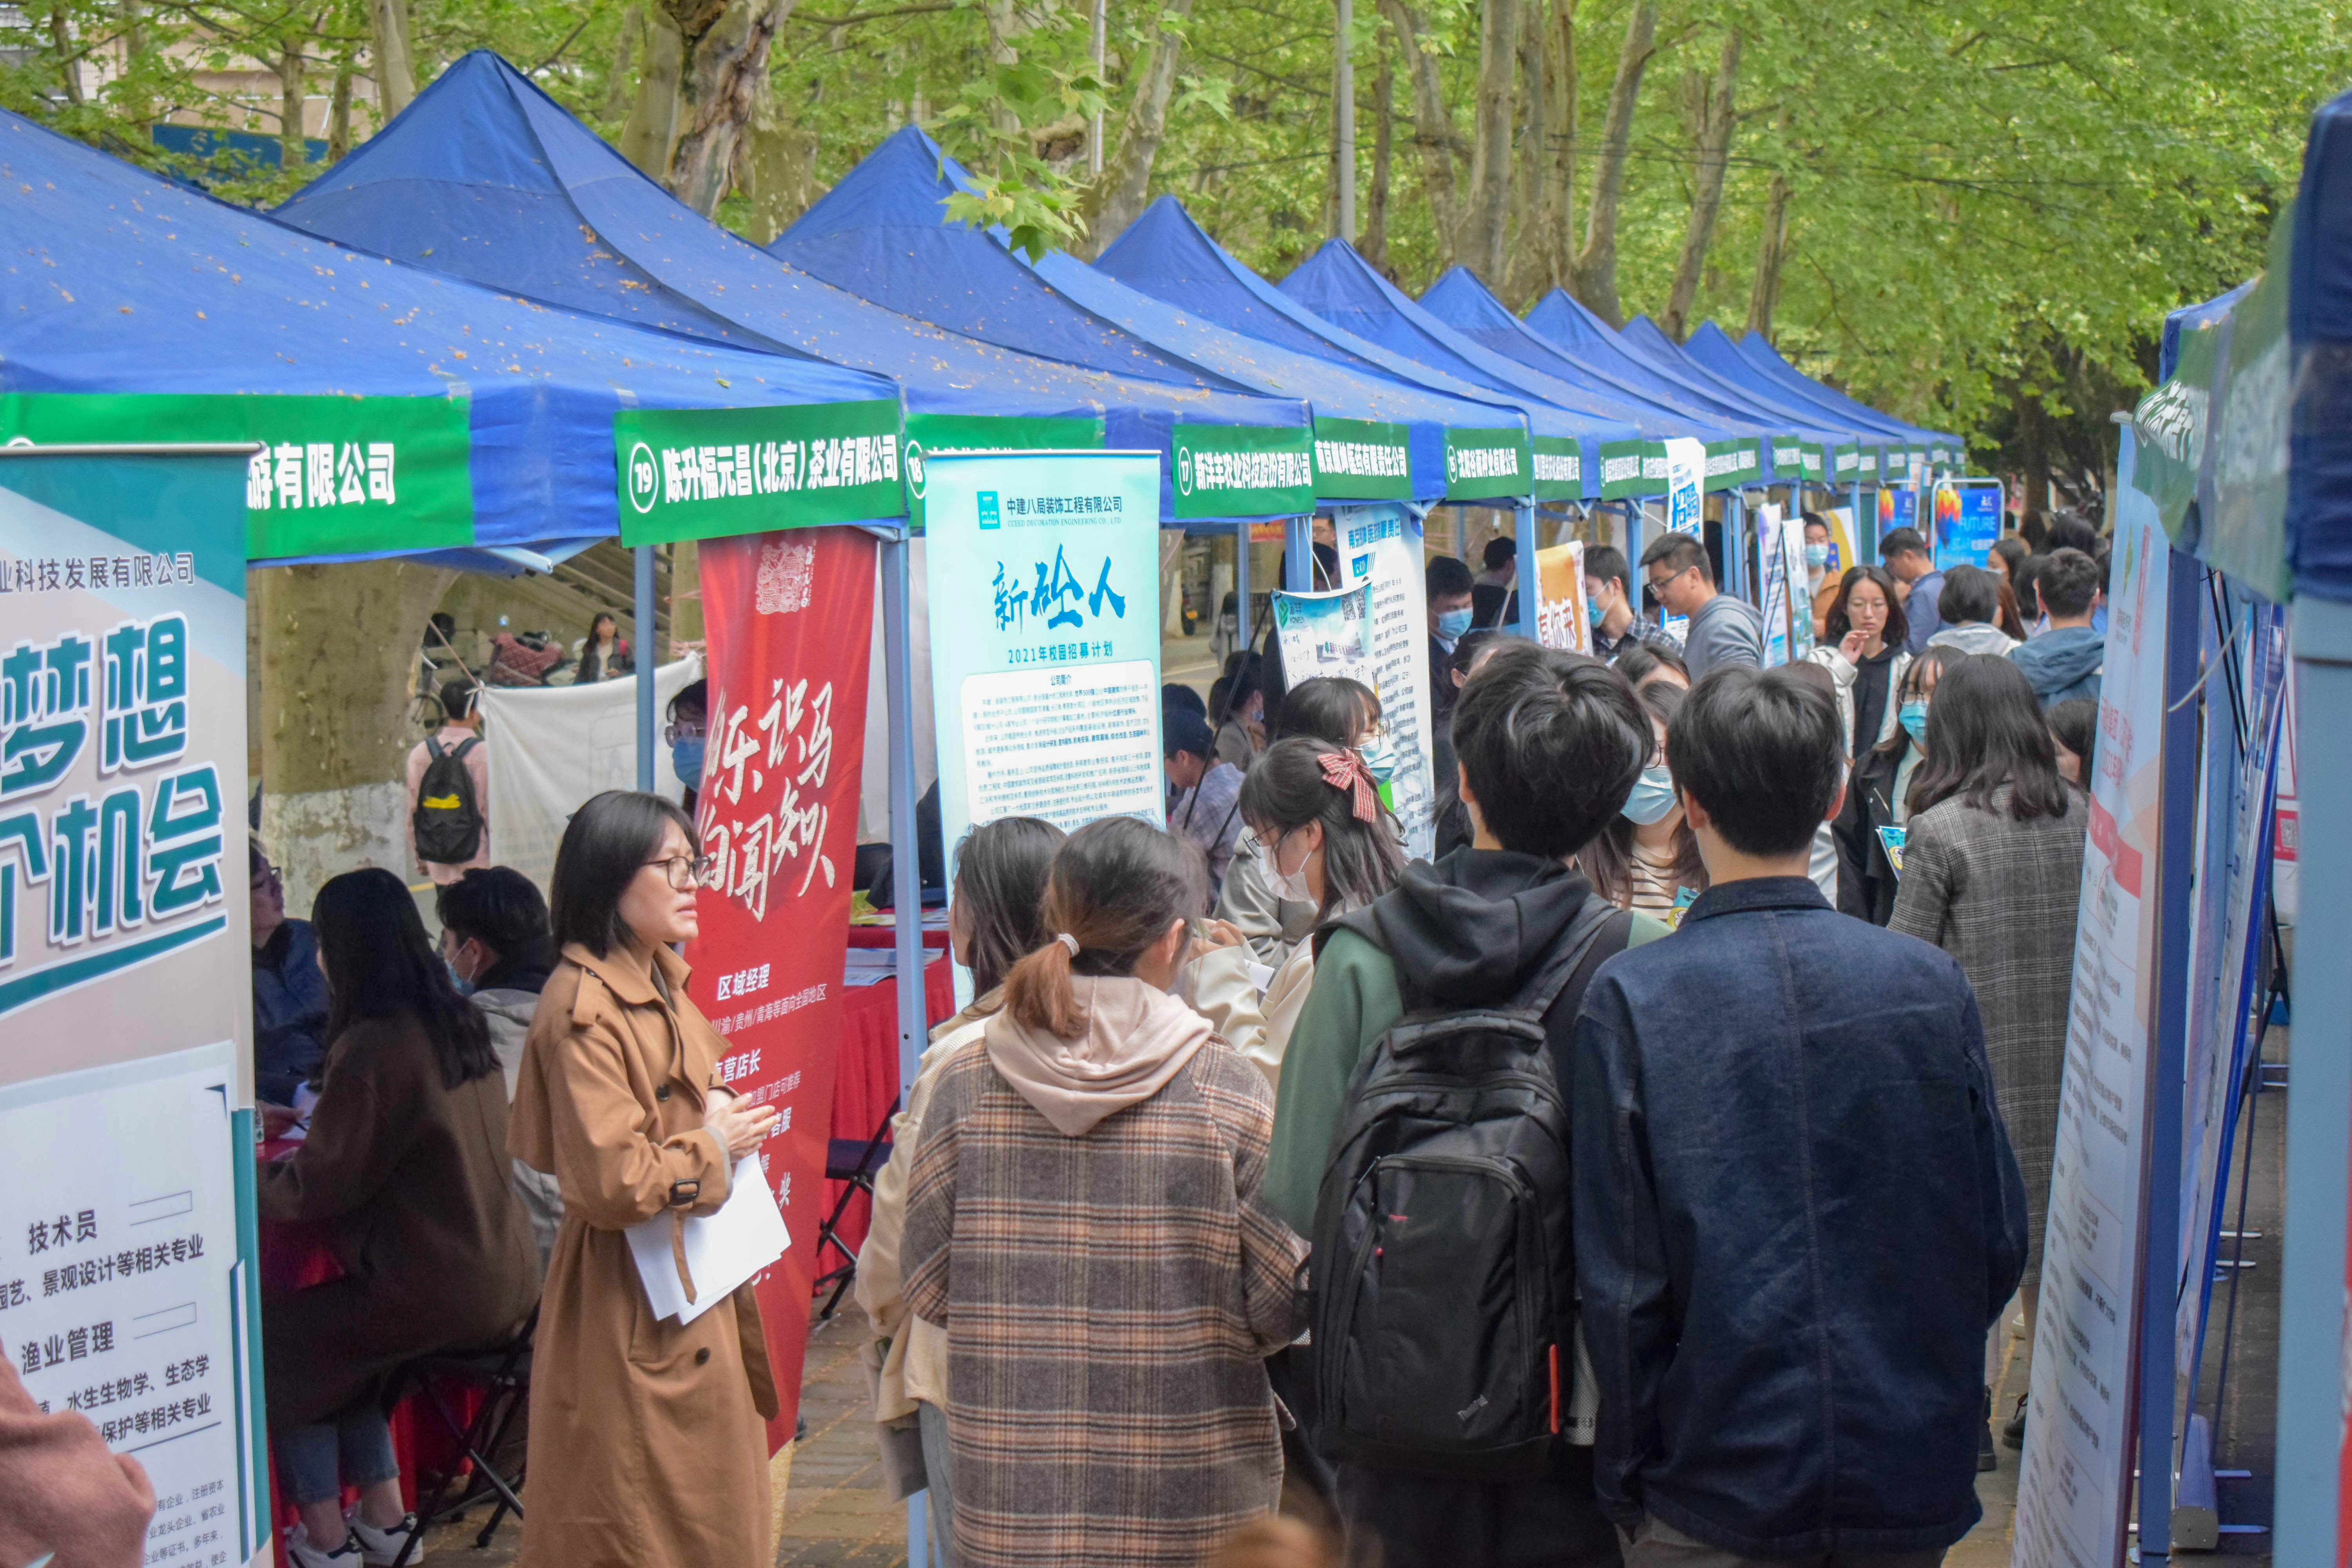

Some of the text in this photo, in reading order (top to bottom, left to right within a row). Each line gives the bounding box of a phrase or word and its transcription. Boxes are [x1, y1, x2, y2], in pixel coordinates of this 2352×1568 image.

[635, 434, 898, 503] 19 陈升福元昌（北京）茶业有限公司
[909, 457, 923, 483] 18
[1194, 452, 1312, 490] 新洋丰农业科技股份有限公司
[1007, 496, 1122, 515] 中建八局装饰工程有限公司
[993, 543, 1126, 635] 新砼人
[1008, 640, 1114, 664] 2021年校园招募计划
[1051, 674, 1071, 686] 公司简介
[0, 613, 187, 799] 梦想
[717, 963, 771, 1001] 区域经理
[764, 1107, 792, 1140] 客服
[29, 1209, 98, 1256] 技术员
[22, 1320, 115, 1376] 渔业管理
[98, 1392, 212, 1444] 保护等相关专业
[147, 1503, 225, 1539] 业龙头企业、省农业
